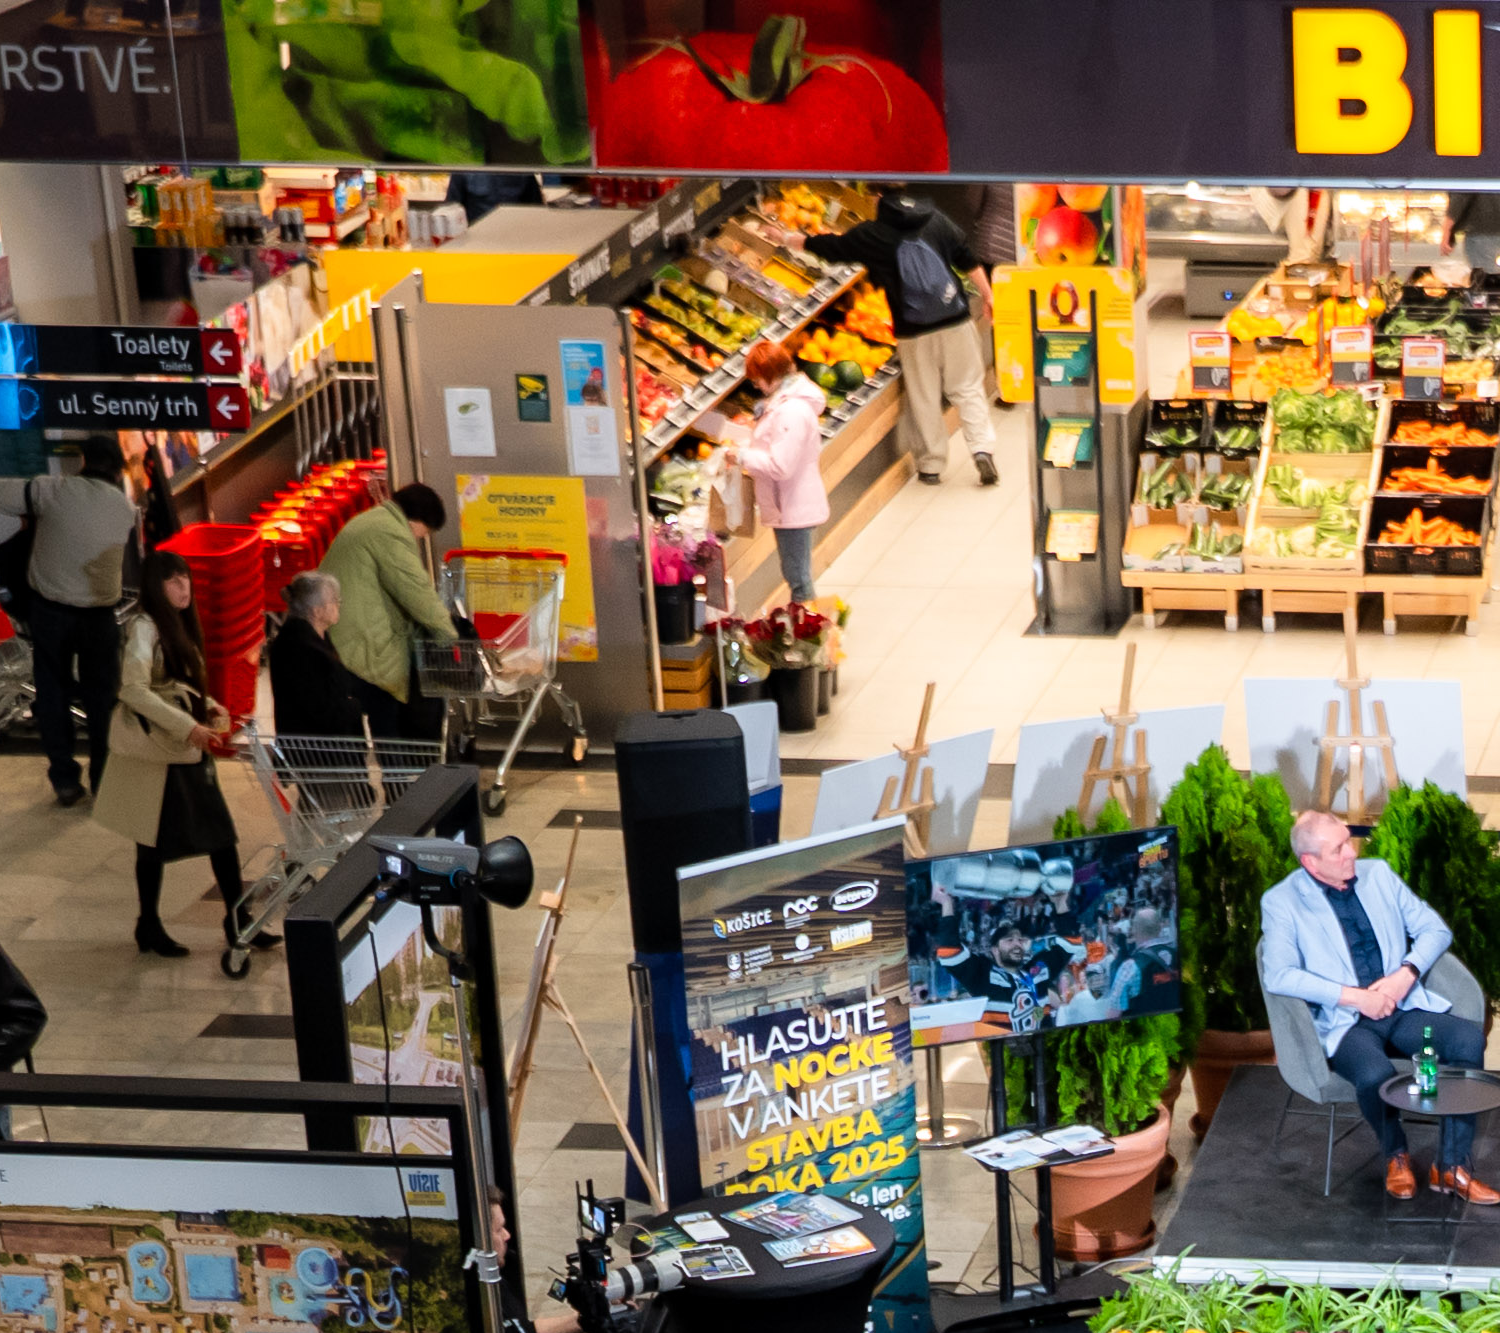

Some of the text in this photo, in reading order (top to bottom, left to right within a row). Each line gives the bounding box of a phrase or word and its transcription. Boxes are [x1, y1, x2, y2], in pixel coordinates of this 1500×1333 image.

[111, 331, 191, 359] Toalety
[159, 360, 194, 371] Toilets
[59, 392, 198, 421] ul. Senný trh
[727, 908, 773, 934] KOŠICE
[720, 996, 888, 1071] HLASUJTE
[720, 1031, 894, 1107] ZA NOCKE
[728, 1068, 893, 1139] V ANKETE
[746, 1109, 883, 1173] STAVBA
[829, 1134, 907, 1184] 2025
[408, 1173, 441, 1192] VÍZIE
[872, 1184, 903, 1204] len
